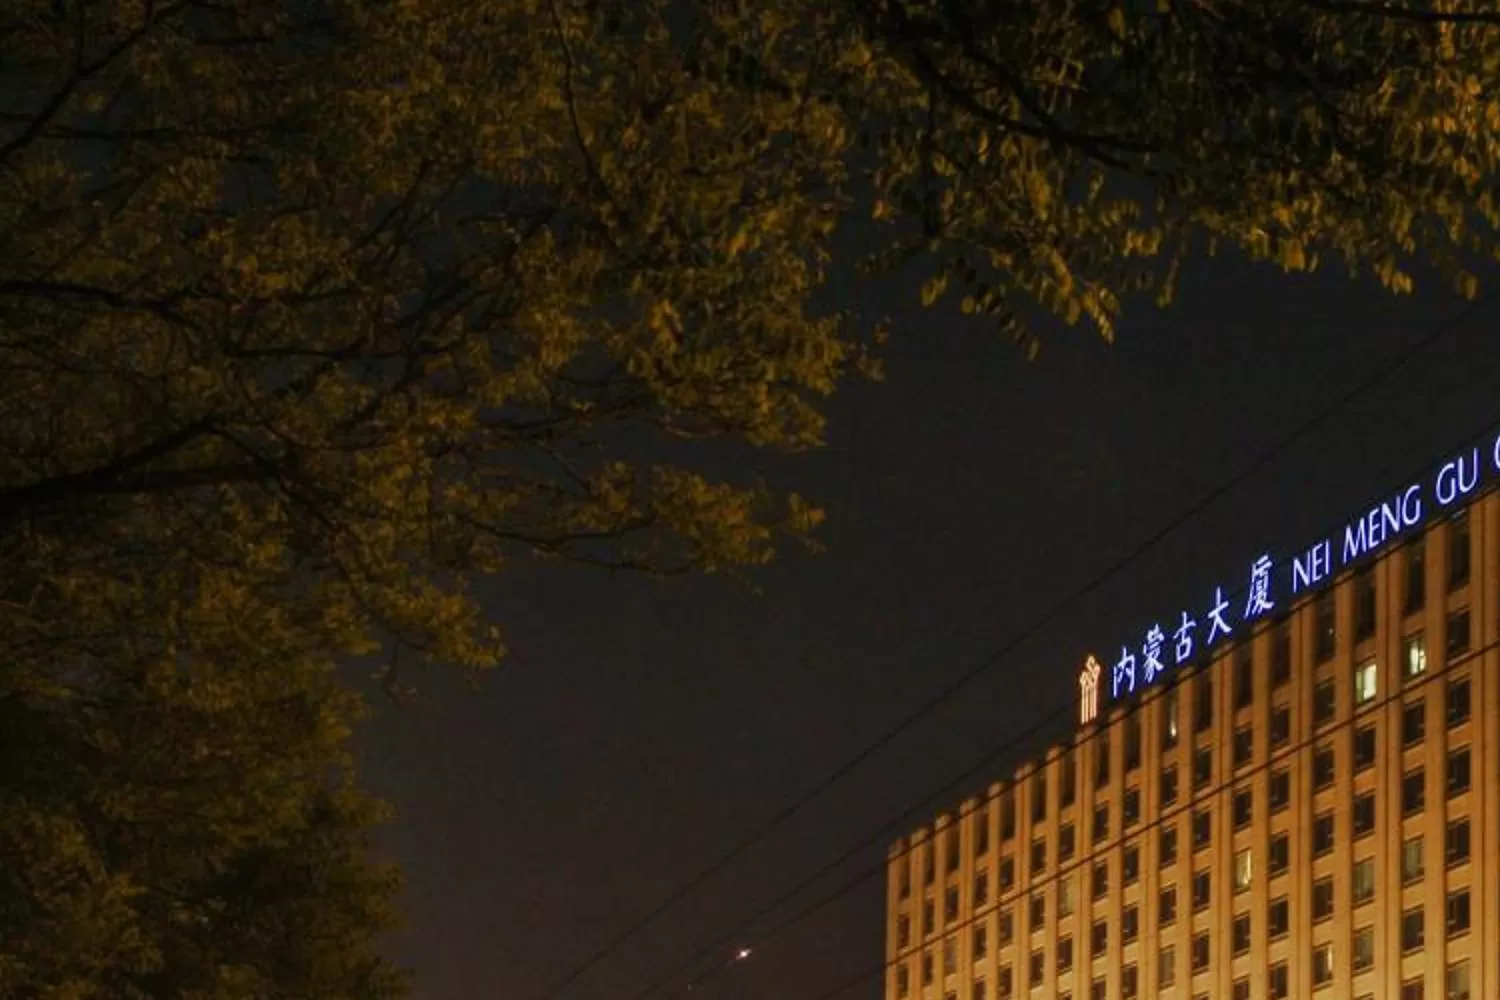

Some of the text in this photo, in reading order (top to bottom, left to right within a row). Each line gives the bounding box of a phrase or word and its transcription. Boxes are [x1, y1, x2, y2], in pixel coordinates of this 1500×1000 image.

[1292, 538, 1331, 594] NEI
[1342, 484, 1422, 566] MENG
[1435, 447, 1479, 505] GU
[1112, 553, 1276, 698] 内蒙古大厦
